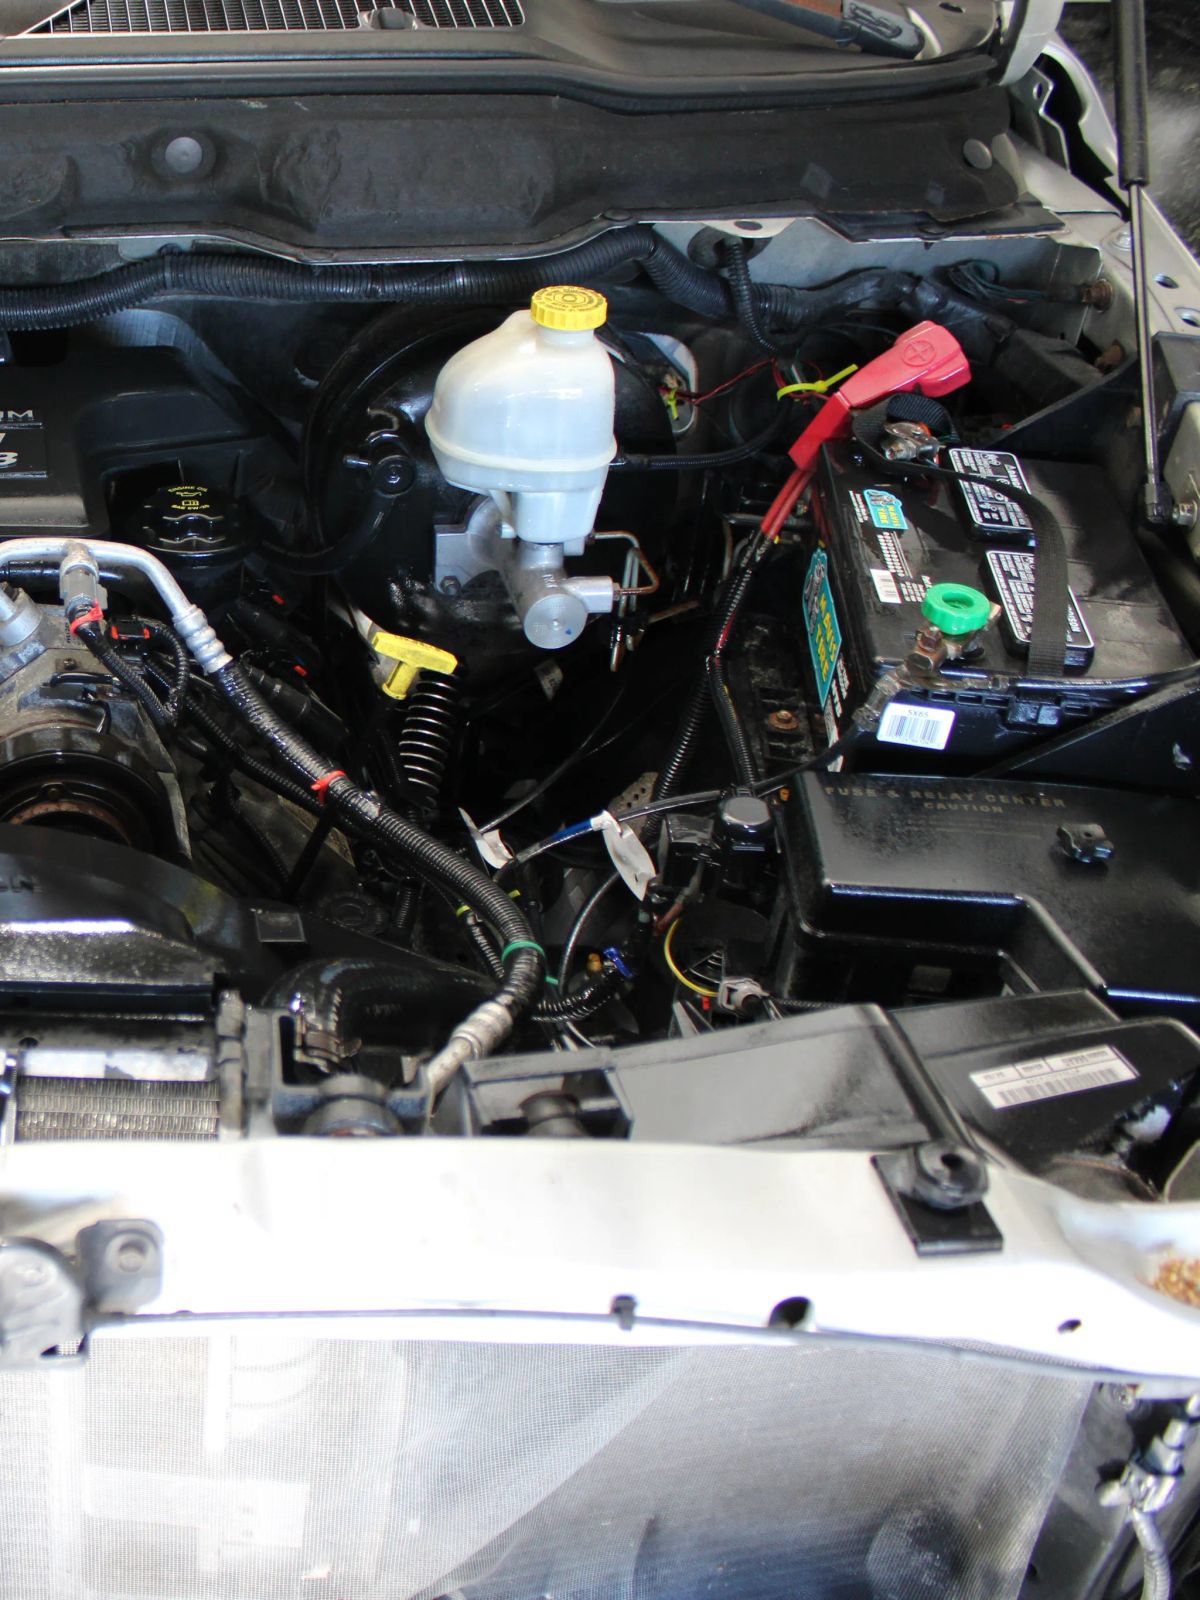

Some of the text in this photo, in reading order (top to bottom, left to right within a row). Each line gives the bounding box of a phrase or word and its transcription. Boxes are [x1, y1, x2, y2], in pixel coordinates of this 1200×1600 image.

[825, 786, 878, 799] FUSE
[911, 789, 975, 802] RELAY
[984, 794, 1067, 808] CENTER
[923, 801, 1005, 814] CAUTION
